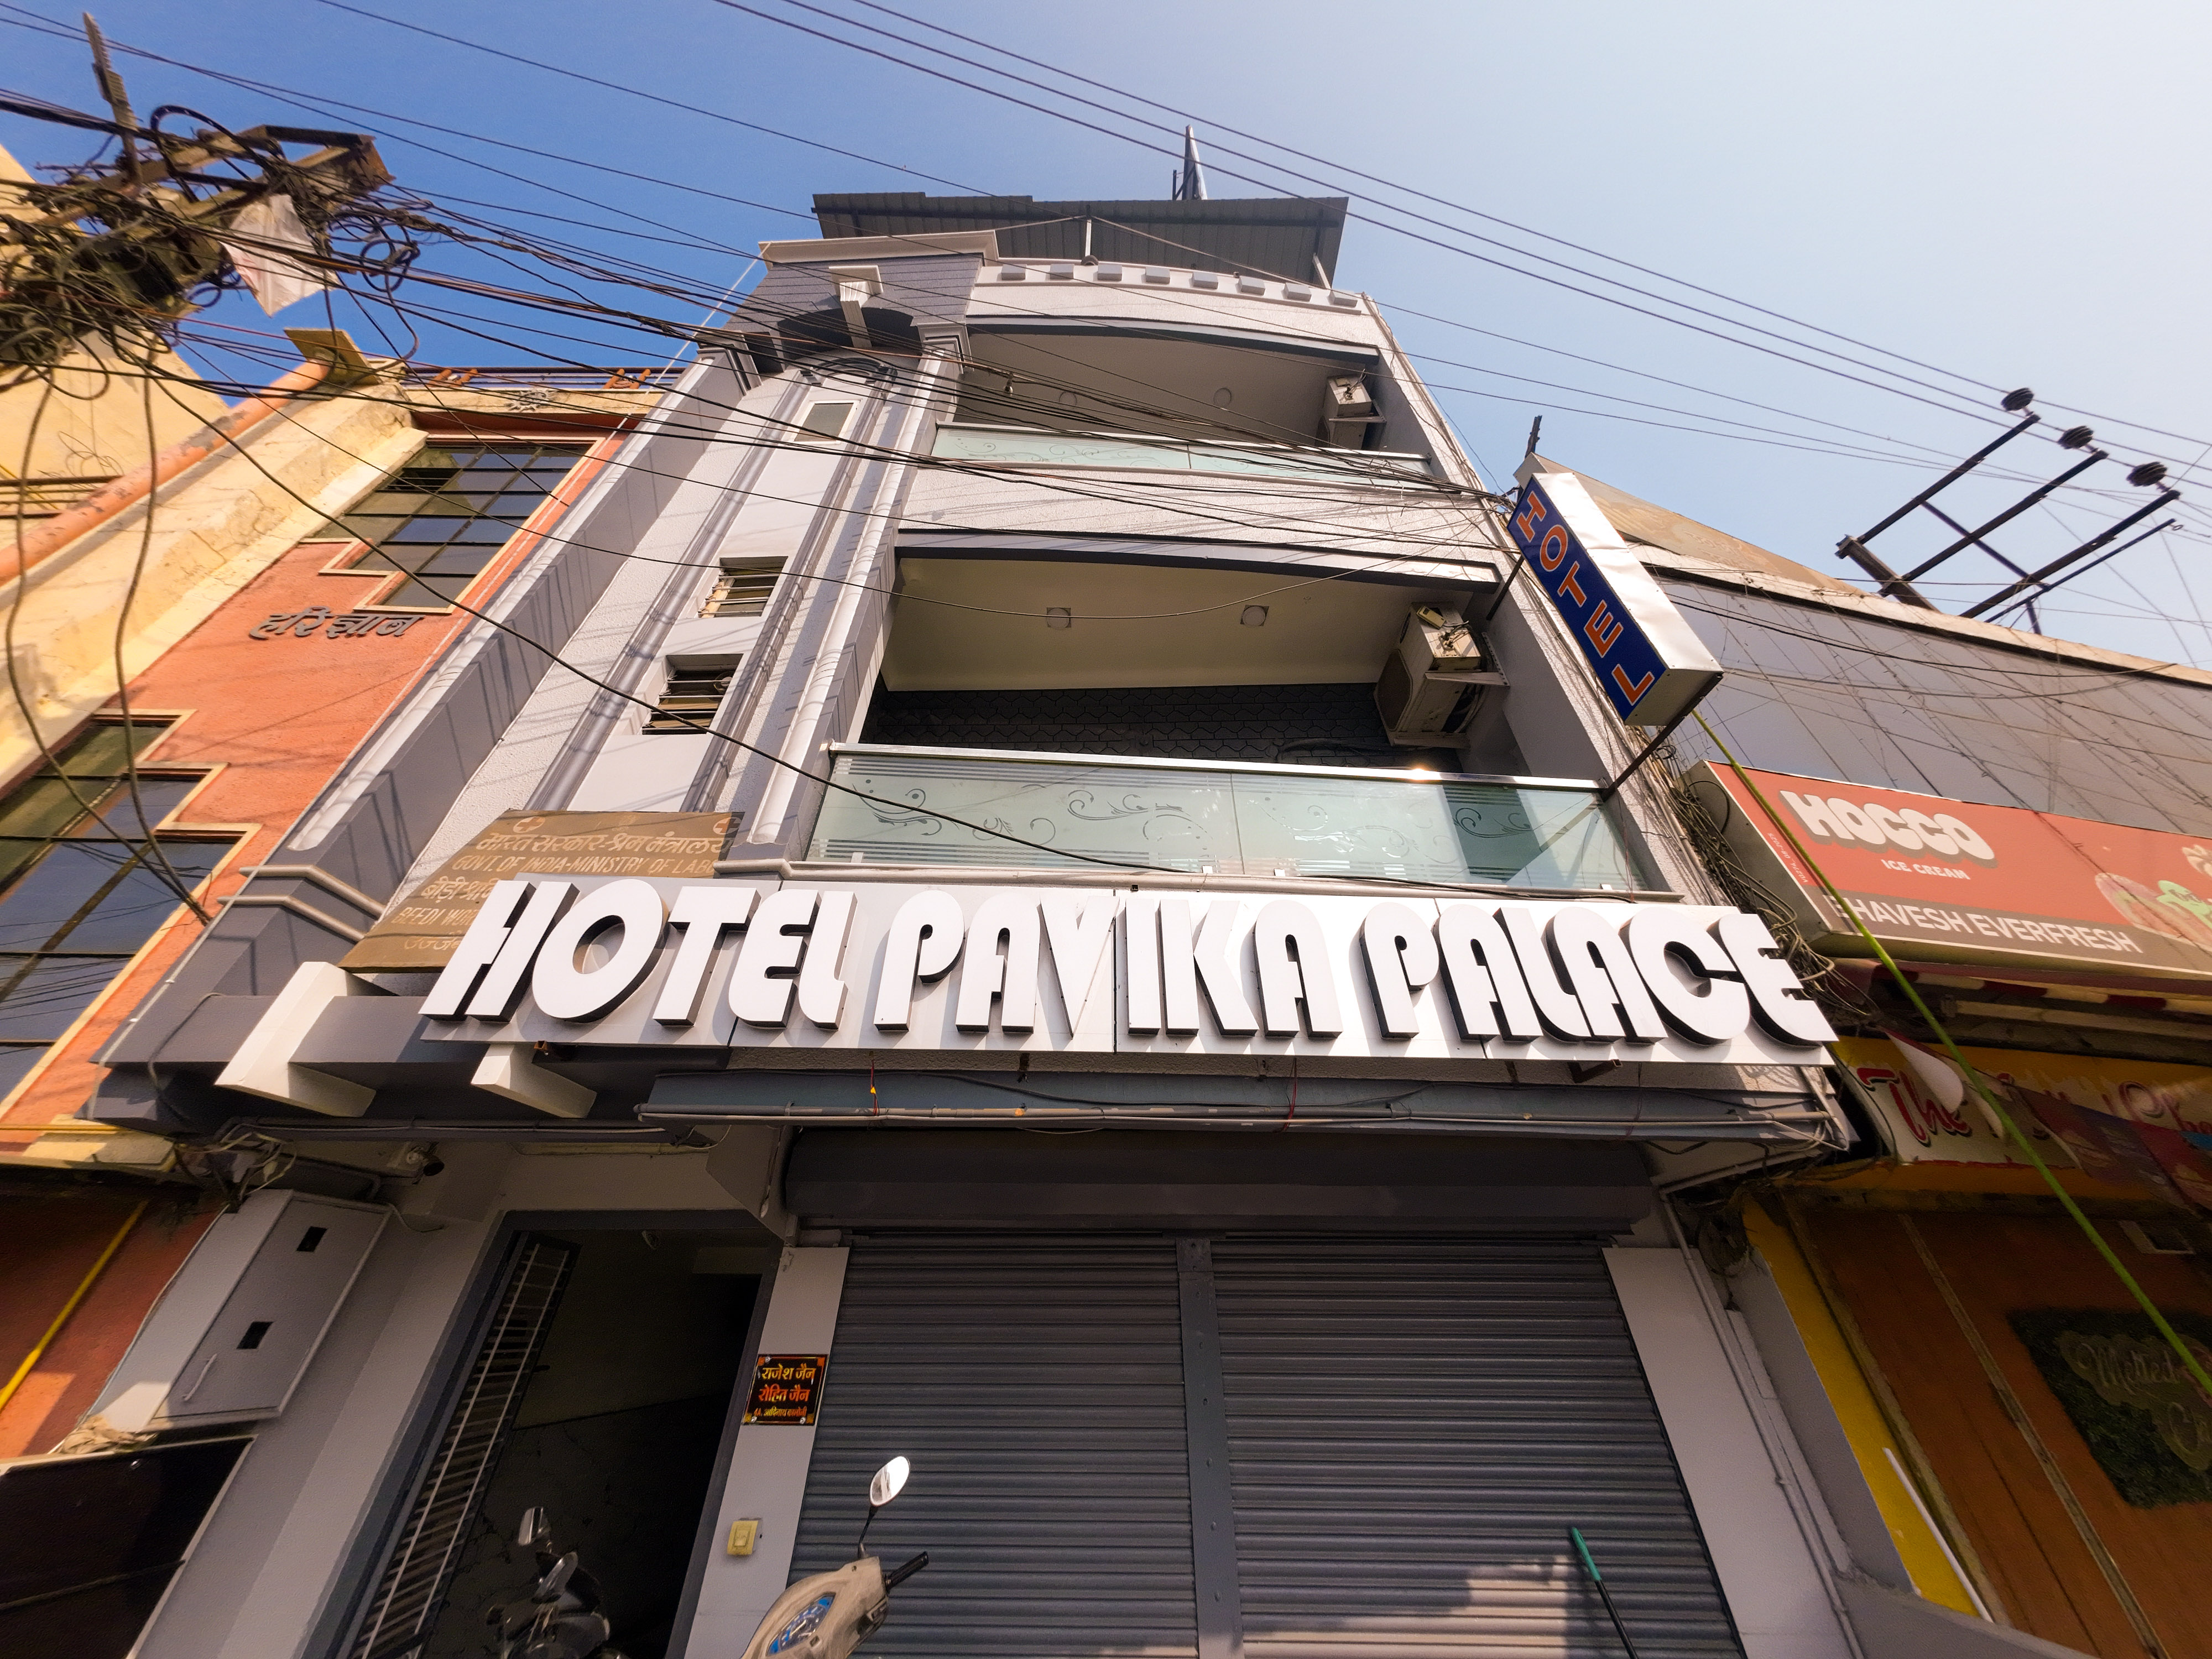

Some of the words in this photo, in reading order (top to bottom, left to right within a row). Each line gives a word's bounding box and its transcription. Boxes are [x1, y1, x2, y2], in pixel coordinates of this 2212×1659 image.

[1516, 490, 1655, 706] HOTEL
[1778, 790, 1996, 863] HOCCO
[476, 832, 539, 851] भारत
[452, 855, 503, 872] GOVT.
[496, 857, 526, 872] OF
[649, 858, 675, 875] OF
[1881, 859, 1912, 872] ICE
[1913, 864, 1971, 880] CREAM
[391, 907, 446, 925] BEEDI
[441, 909, 479, 926] WOR
[1965, 913, 2143, 953] EVERFRESH
[419, 879, 857, 1030] HOTEL
[874, 890, 1343, 1039] PAVIKA
[1360, 902, 1839, 1047] PALACE
[761, 1363, 795, 1380] राजेश
[795, 1363, 817, 1380] जैन
[758, 1384, 788, 1402] रोहित
[789, 1384, 811, 1402] जैन
